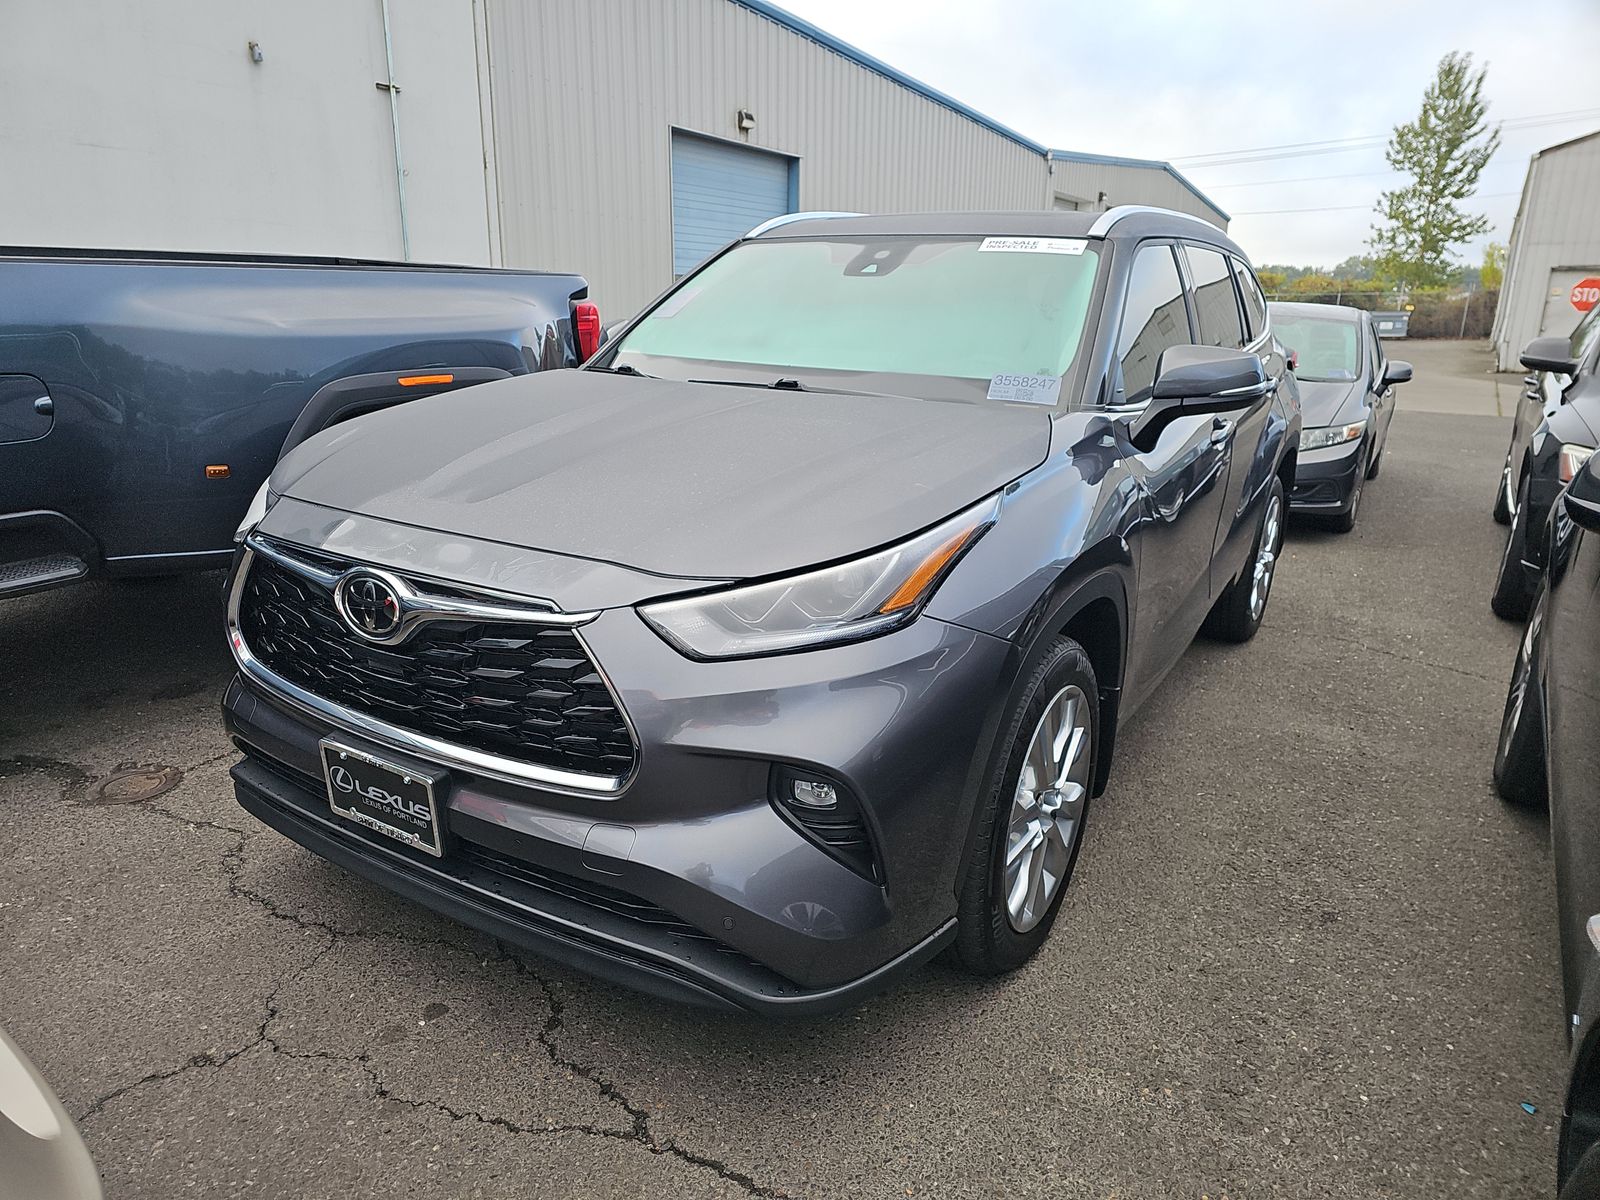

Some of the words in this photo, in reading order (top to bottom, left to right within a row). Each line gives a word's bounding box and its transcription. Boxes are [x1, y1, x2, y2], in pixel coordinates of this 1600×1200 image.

[1572, 287, 1600, 303] STO
[994, 374, 1056, 390] 3558247
[354, 779, 432, 821] LEXUS
[361, 797, 382, 811] LEXUS
[382, 804, 392, 814] OF
[392, 809, 428, 829] PORTLAND
